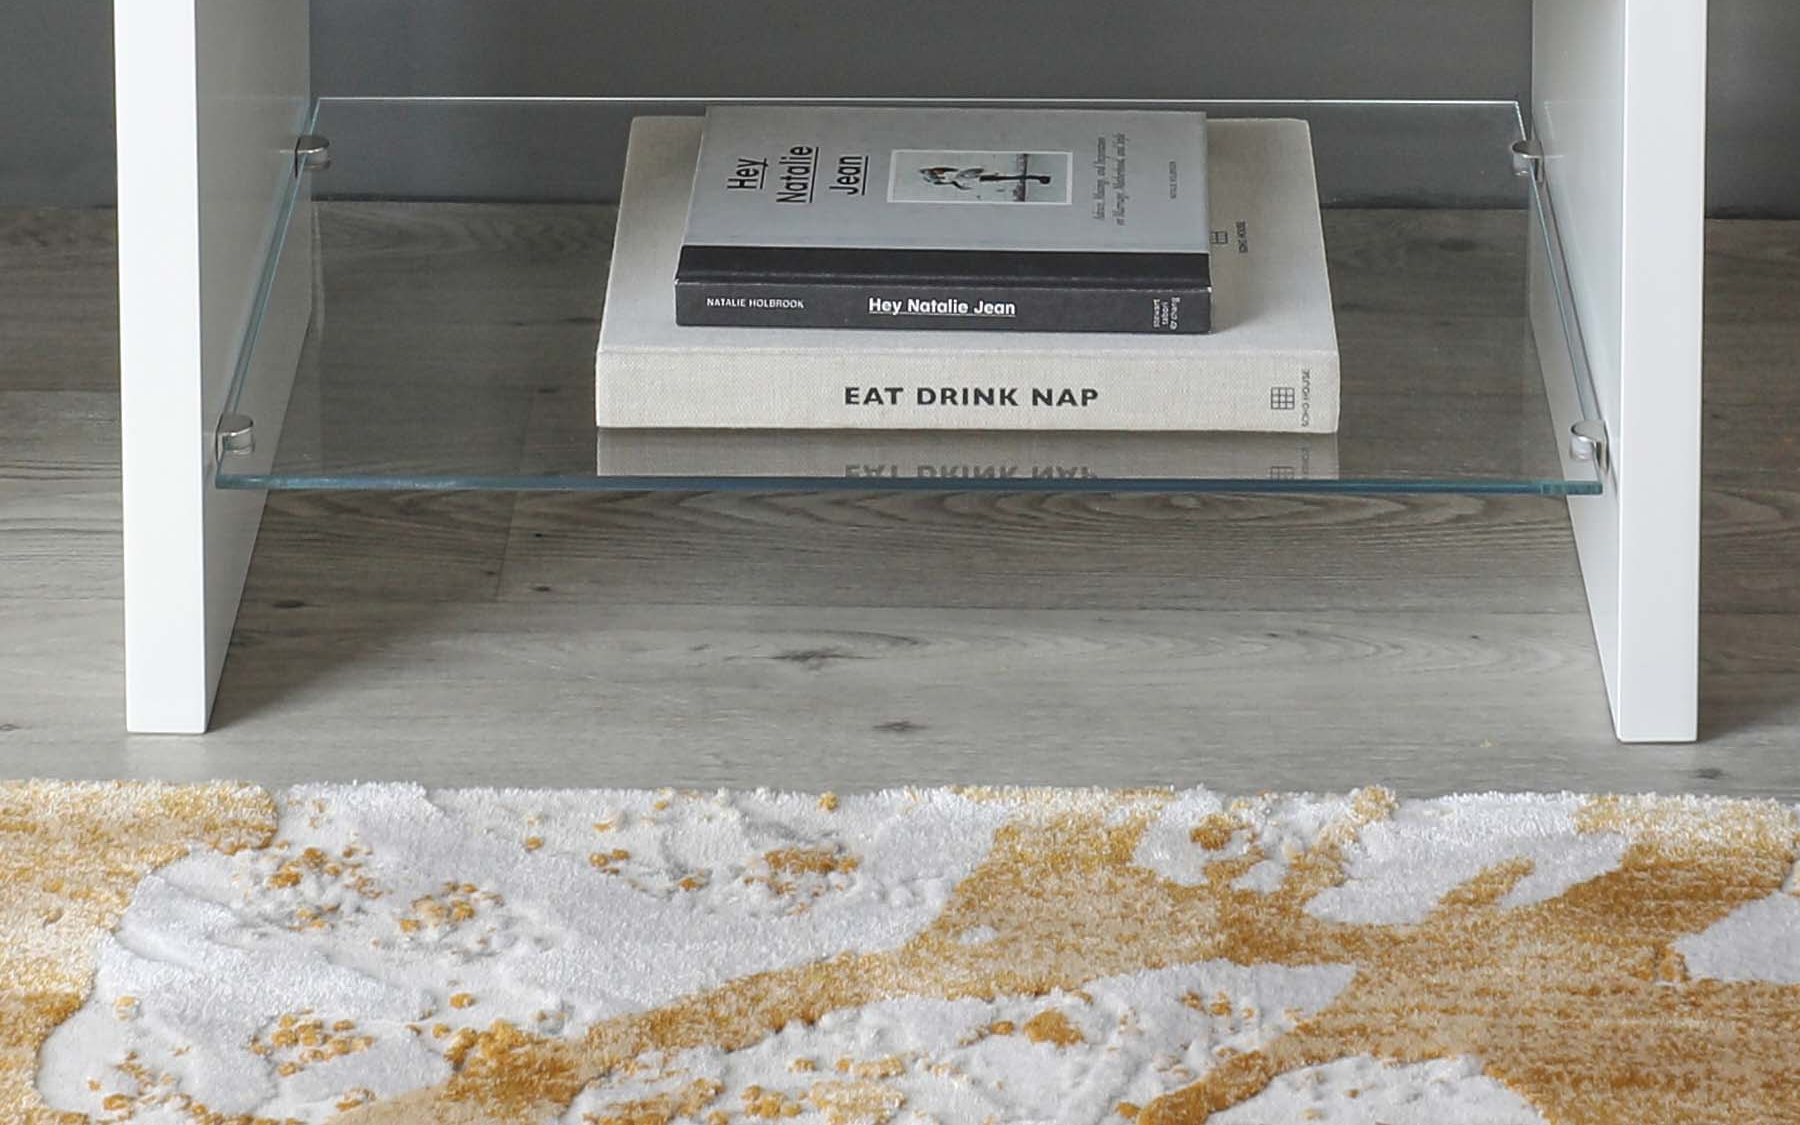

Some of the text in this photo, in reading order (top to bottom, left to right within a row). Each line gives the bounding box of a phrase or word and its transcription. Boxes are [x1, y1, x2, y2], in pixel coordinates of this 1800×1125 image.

[727, 158, 768, 189] Hey
[776, 146, 813, 203] Natalie
[829, 156, 862, 195] Jean
[706, 298, 804, 309] NATALIE HOLBROOK
[869, 297, 1015, 315] Hey Natalie Jean
[844, 386, 1099, 406] EAT DRINK NAP
